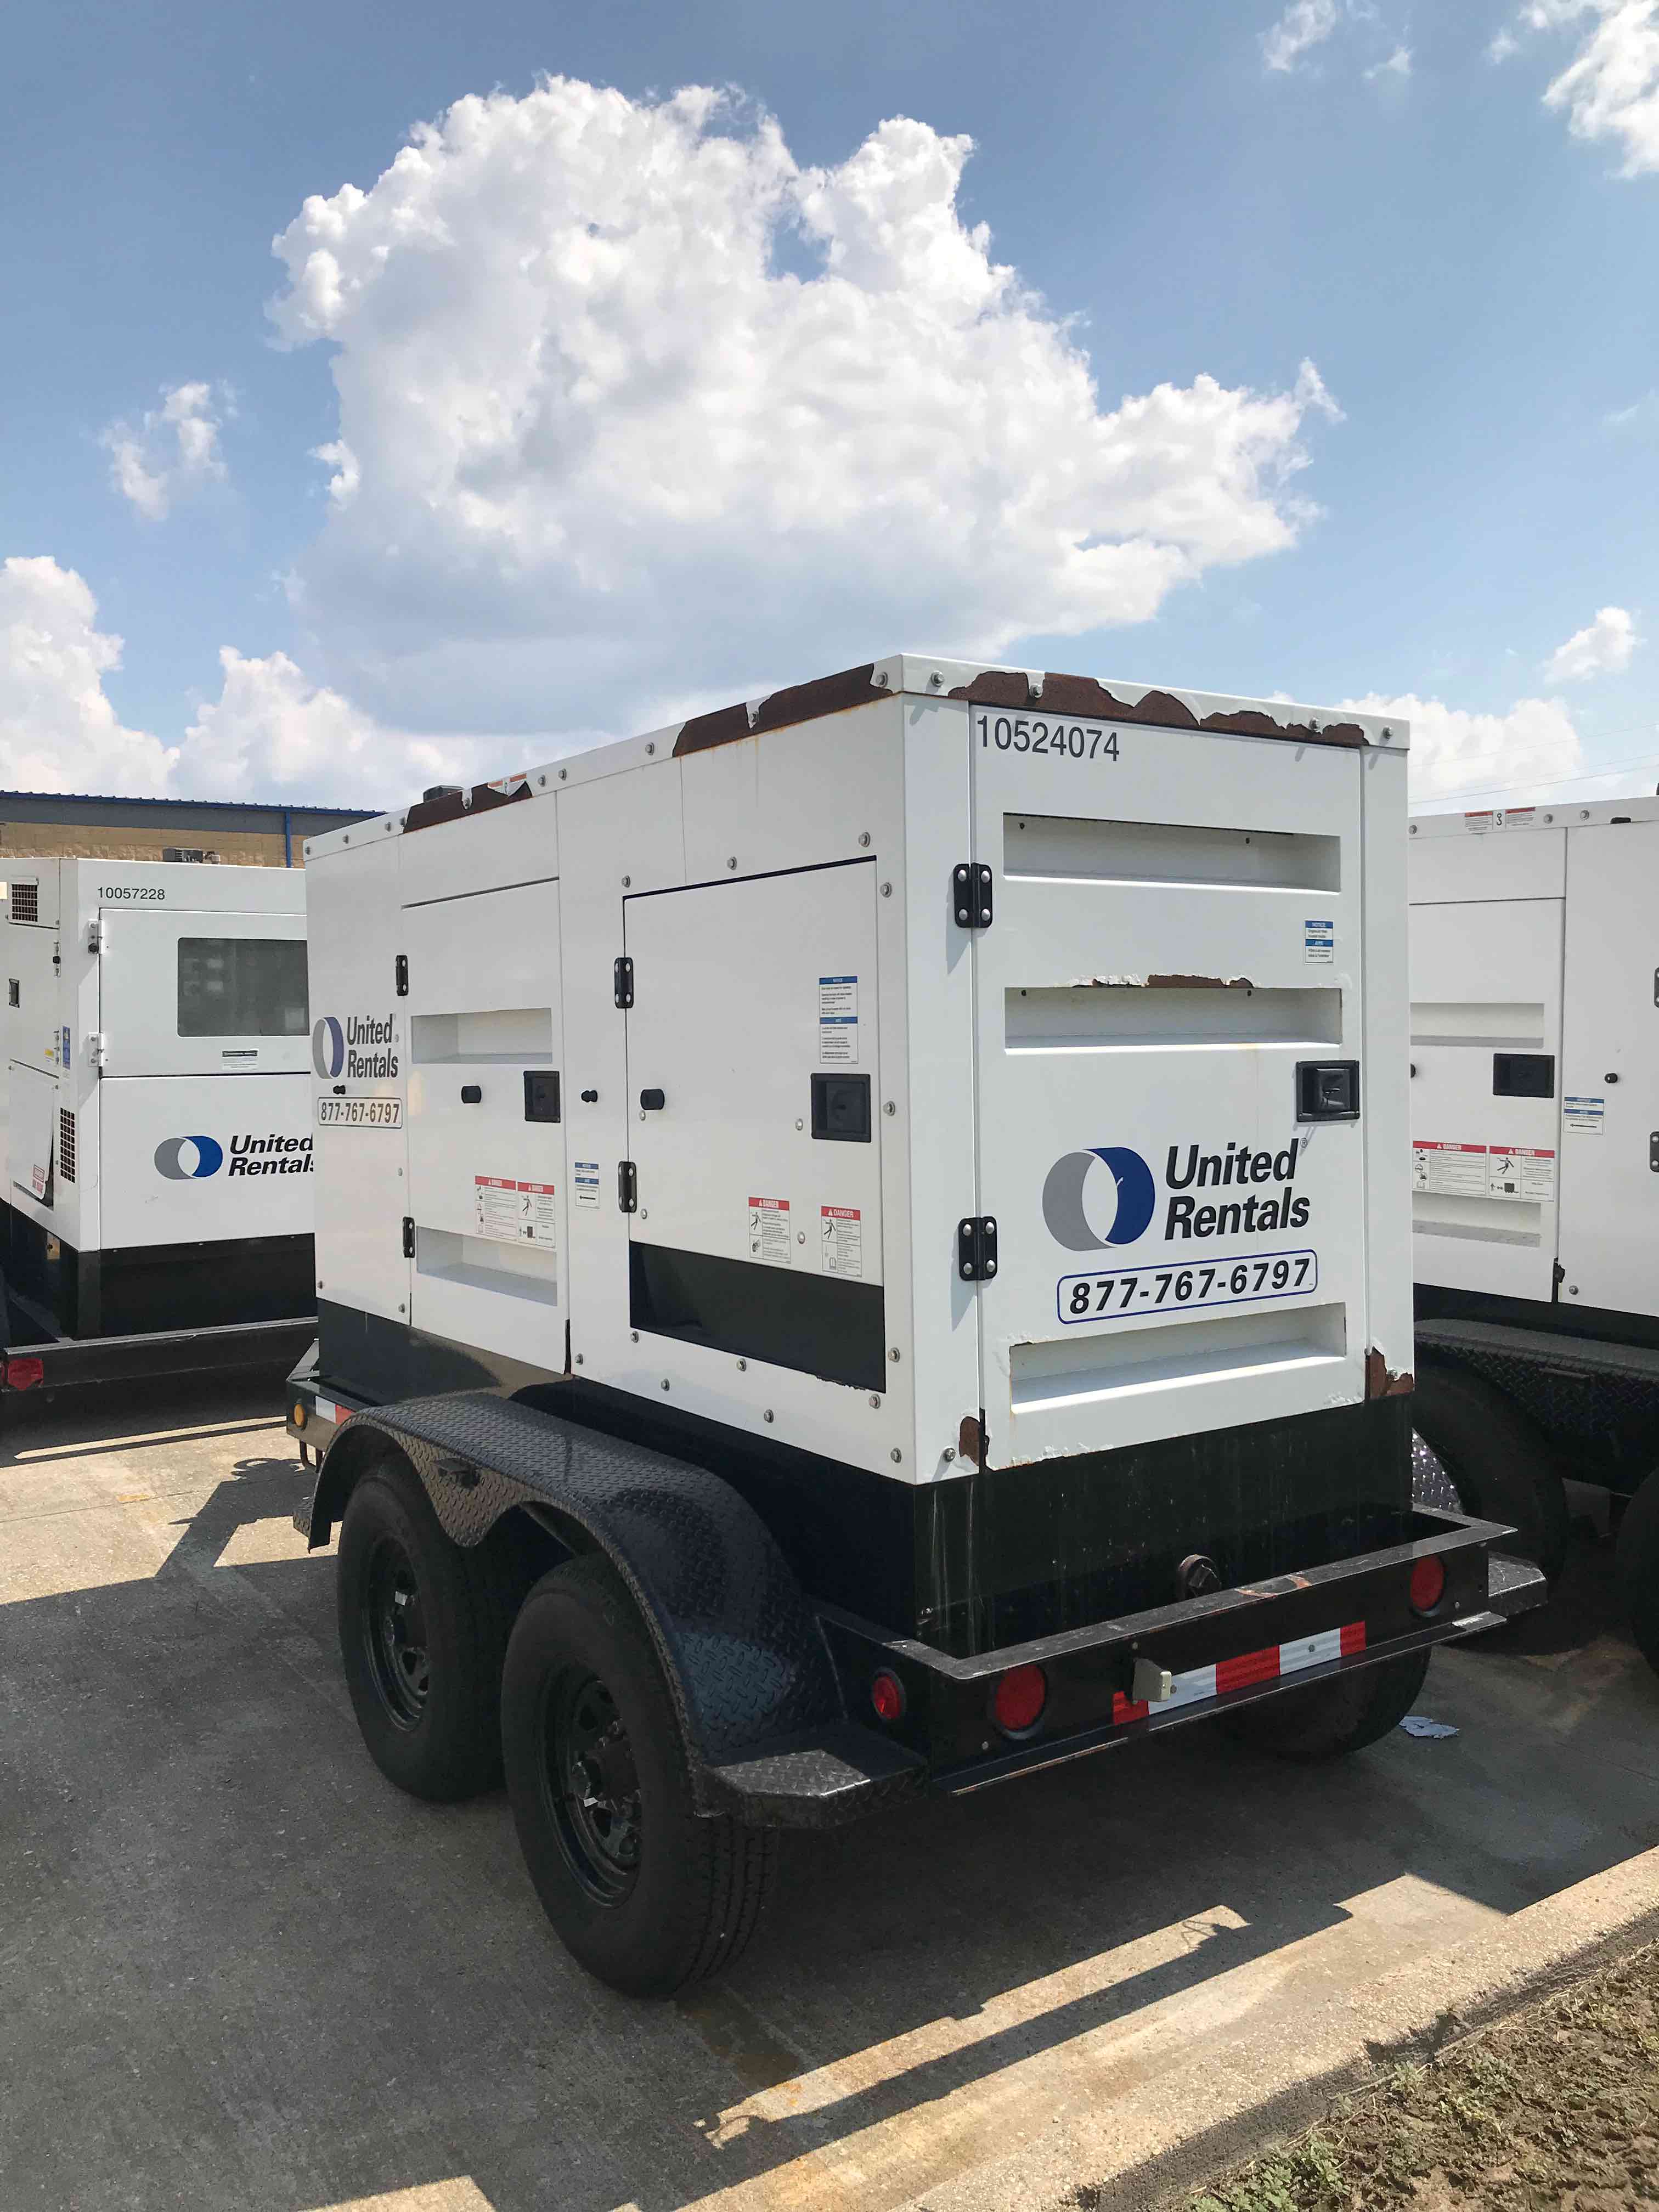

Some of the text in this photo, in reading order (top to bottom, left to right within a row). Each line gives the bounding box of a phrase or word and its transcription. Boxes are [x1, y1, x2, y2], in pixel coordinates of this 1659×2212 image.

[977, 715, 1120, 761] 10524074
[98, 887, 165, 900] 10057228
[347, 1013, 393, 1045] United
[347, 1048, 398, 1078] Rentals
[320, 1102, 399, 1124] 877-767-6797
[229, 1132, 313, 1154] United
[1165, 1137, 1299, 1190] United
[833, 1209, 854, 1218] DANGER
[1164, 1187, 1311, 1240] Rentals
[1069, 1258, 1311, 1314] 877-767-6797
